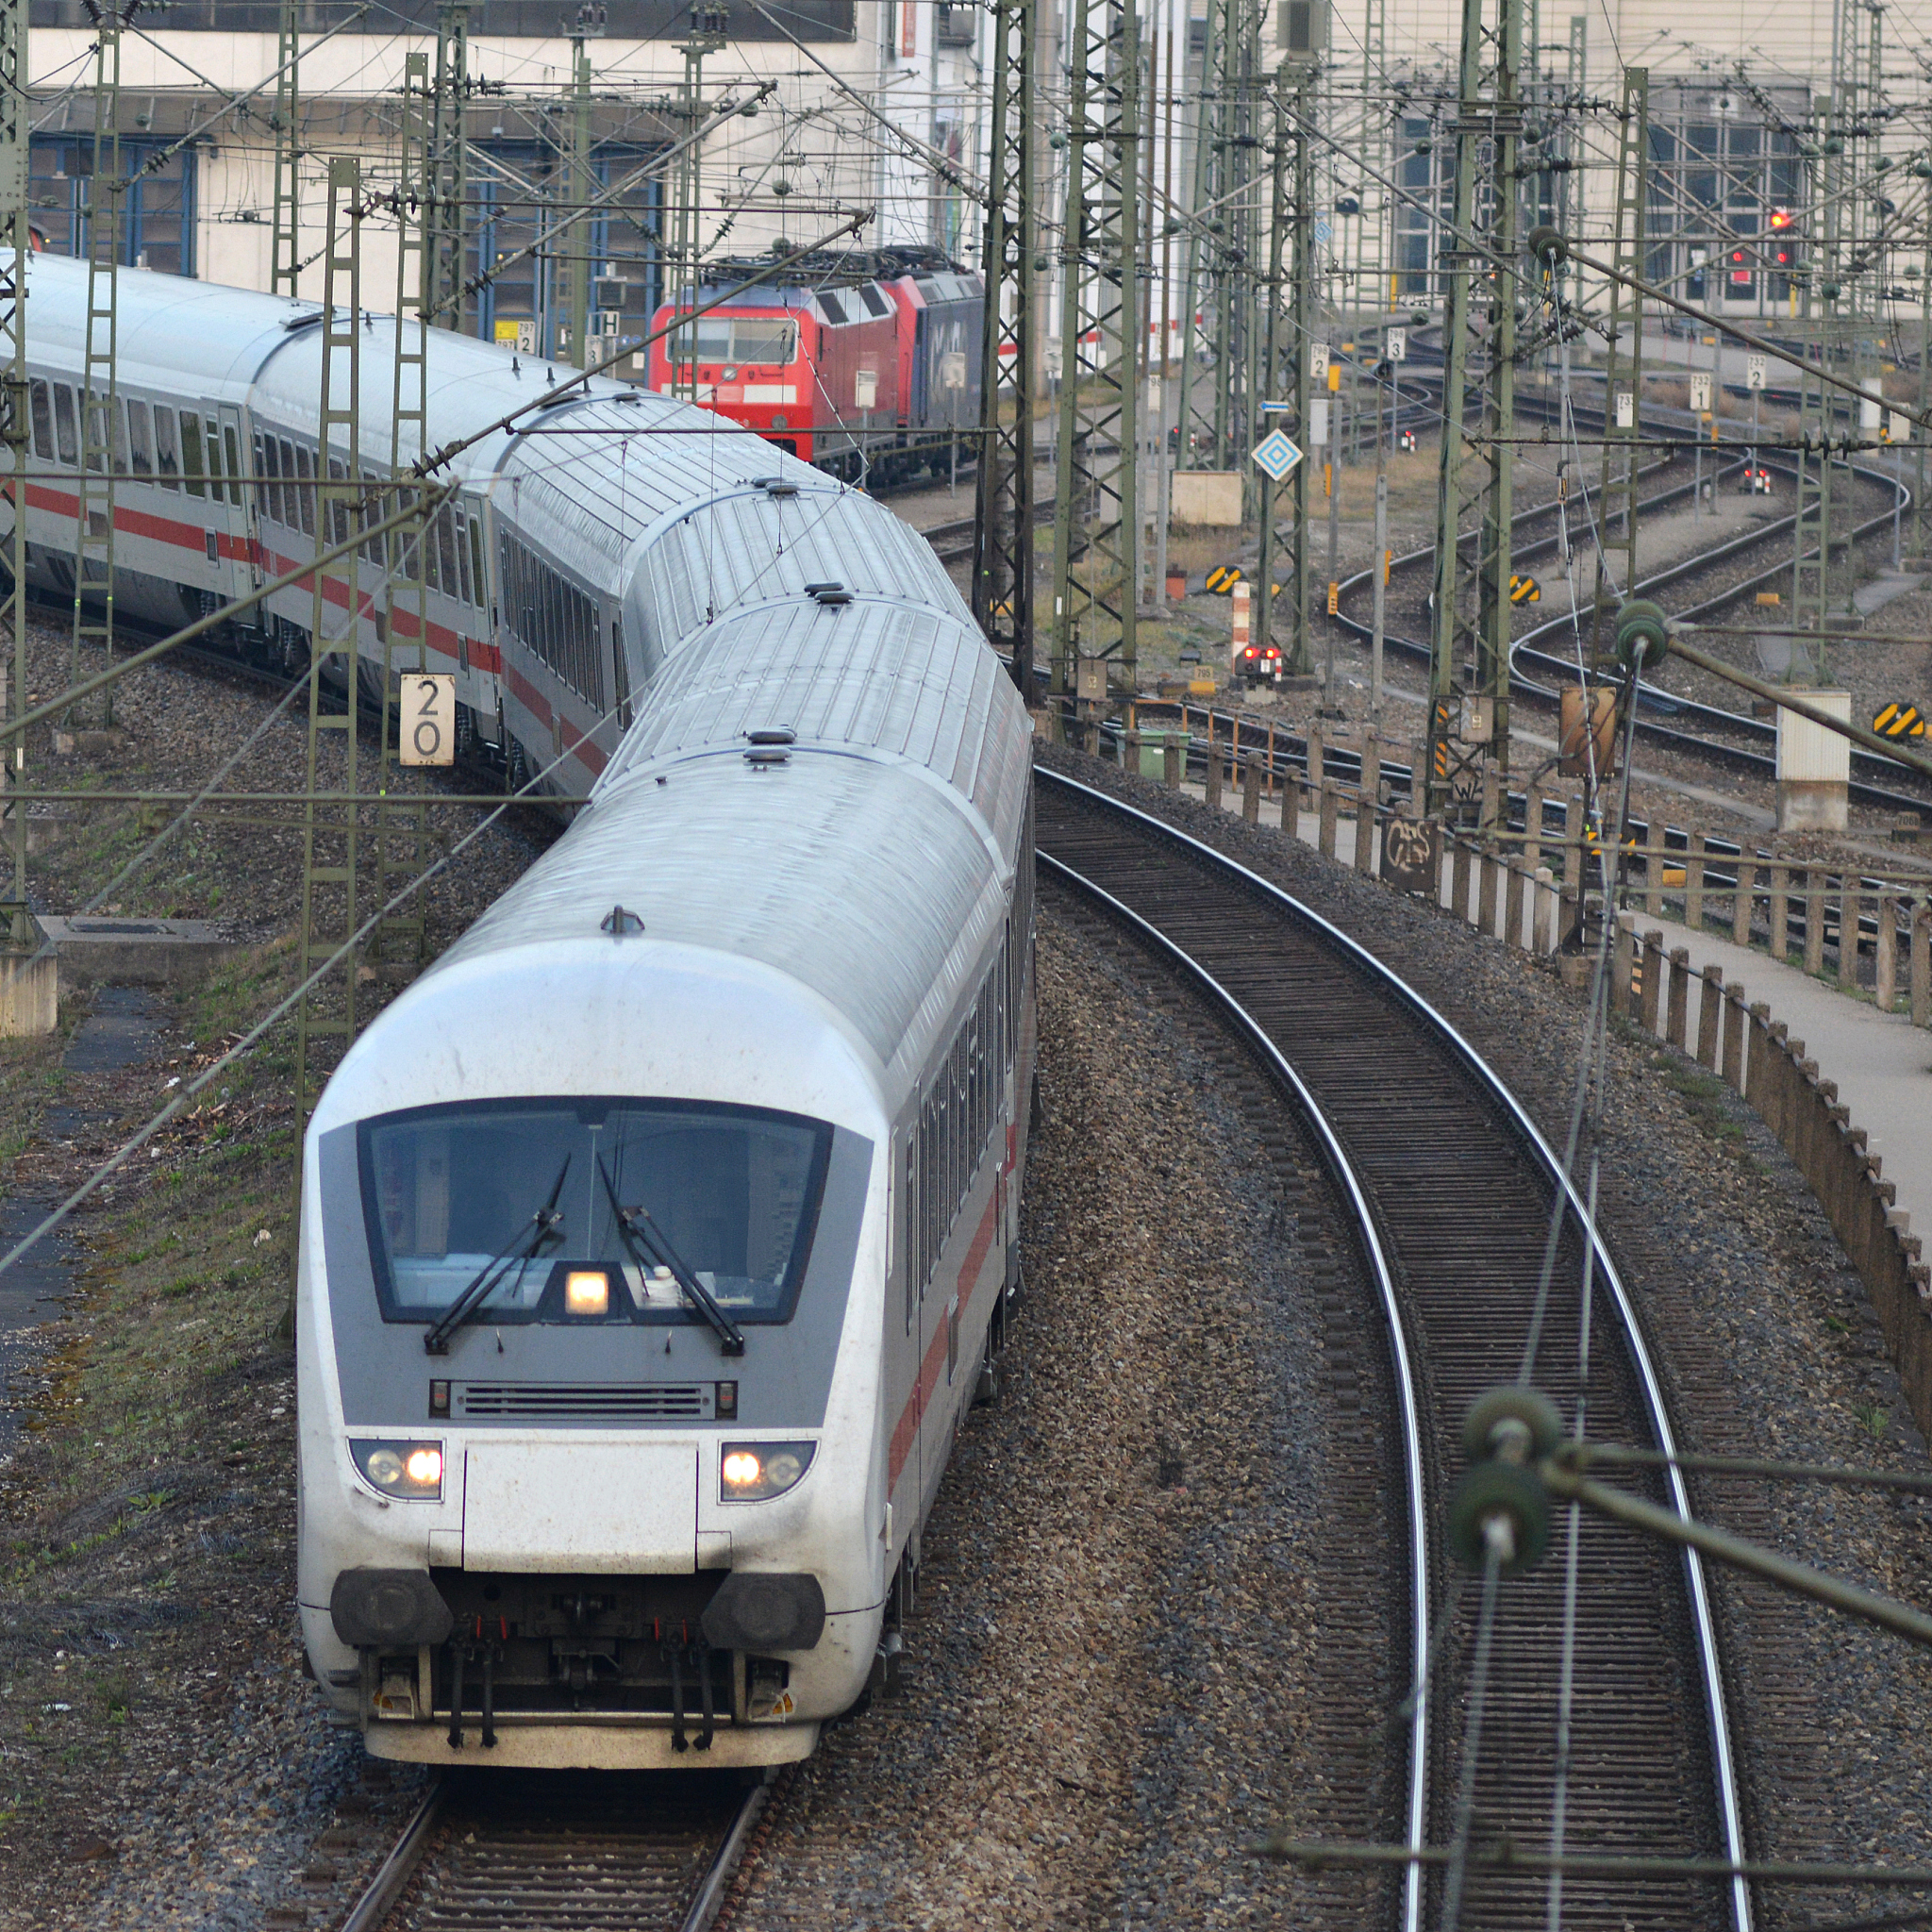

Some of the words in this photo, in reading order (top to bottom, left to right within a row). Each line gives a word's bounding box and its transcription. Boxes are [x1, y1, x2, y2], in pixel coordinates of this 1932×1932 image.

[522, 337, 530, 352] 2
[1392, 342, 1400, 357] 3
[1315, 359, 1323, 375] 2
[1749, 357, 1765, 367] 732
[1692, 375, 1708, 386] 732
[1752, 371, 1761, 386] 2
[1698, 390, 1703, 407] 1
